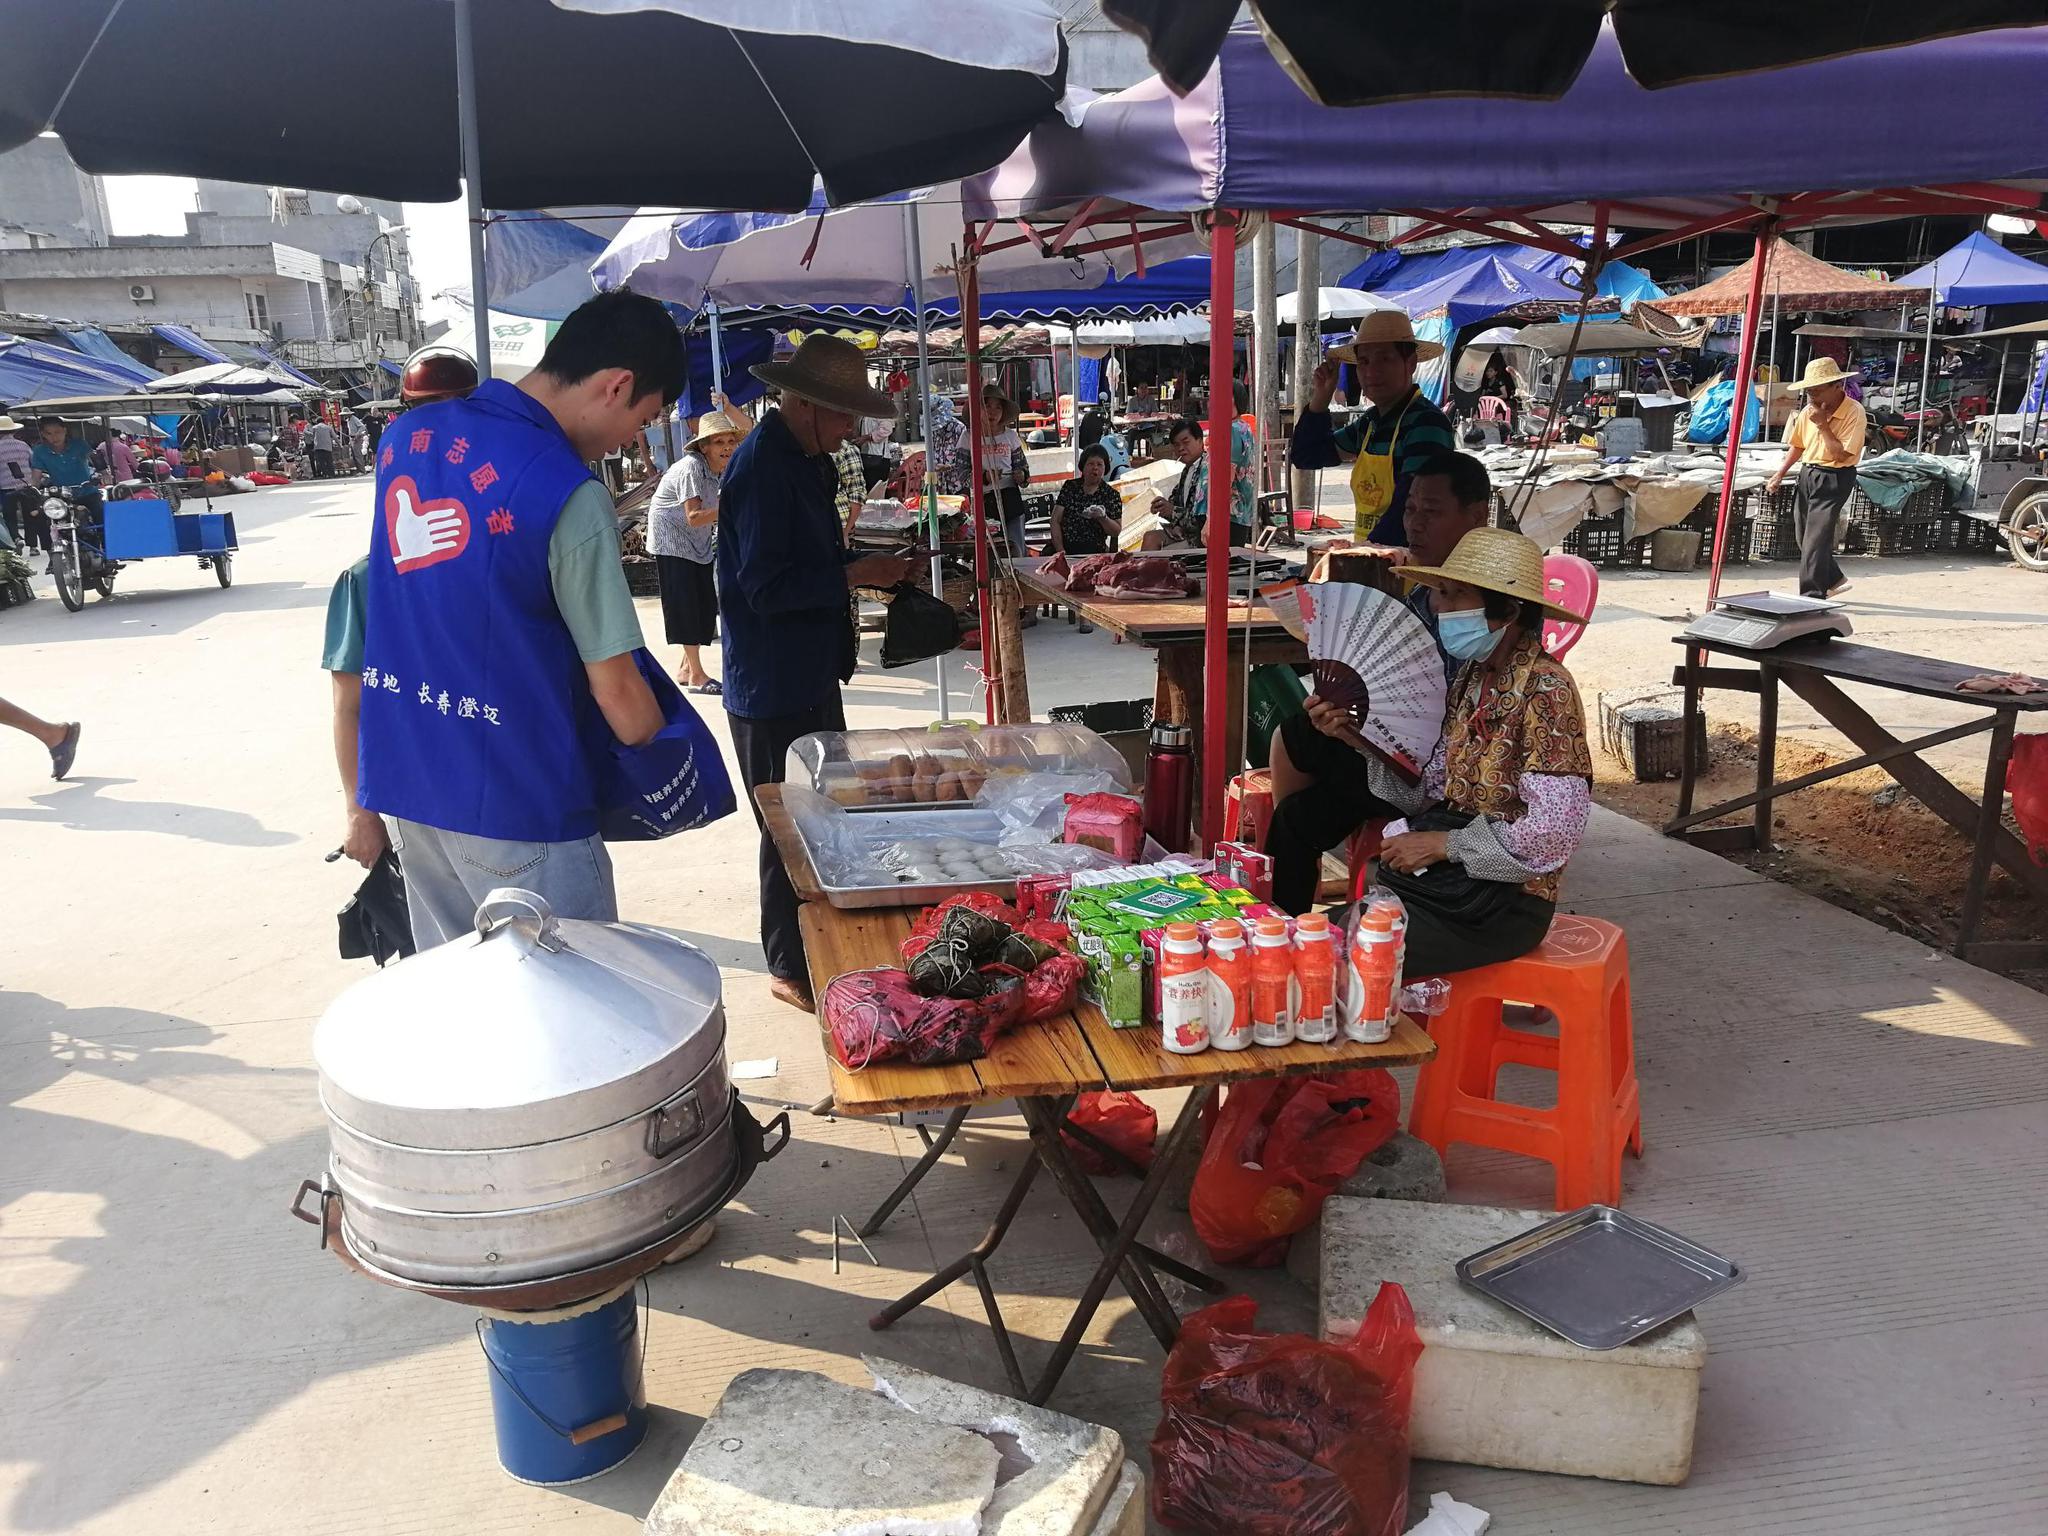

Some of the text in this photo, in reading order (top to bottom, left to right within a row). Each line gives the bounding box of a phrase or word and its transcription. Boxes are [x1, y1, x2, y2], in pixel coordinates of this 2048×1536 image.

[362, 666, 501, 725] 福地 长寿澄迈
